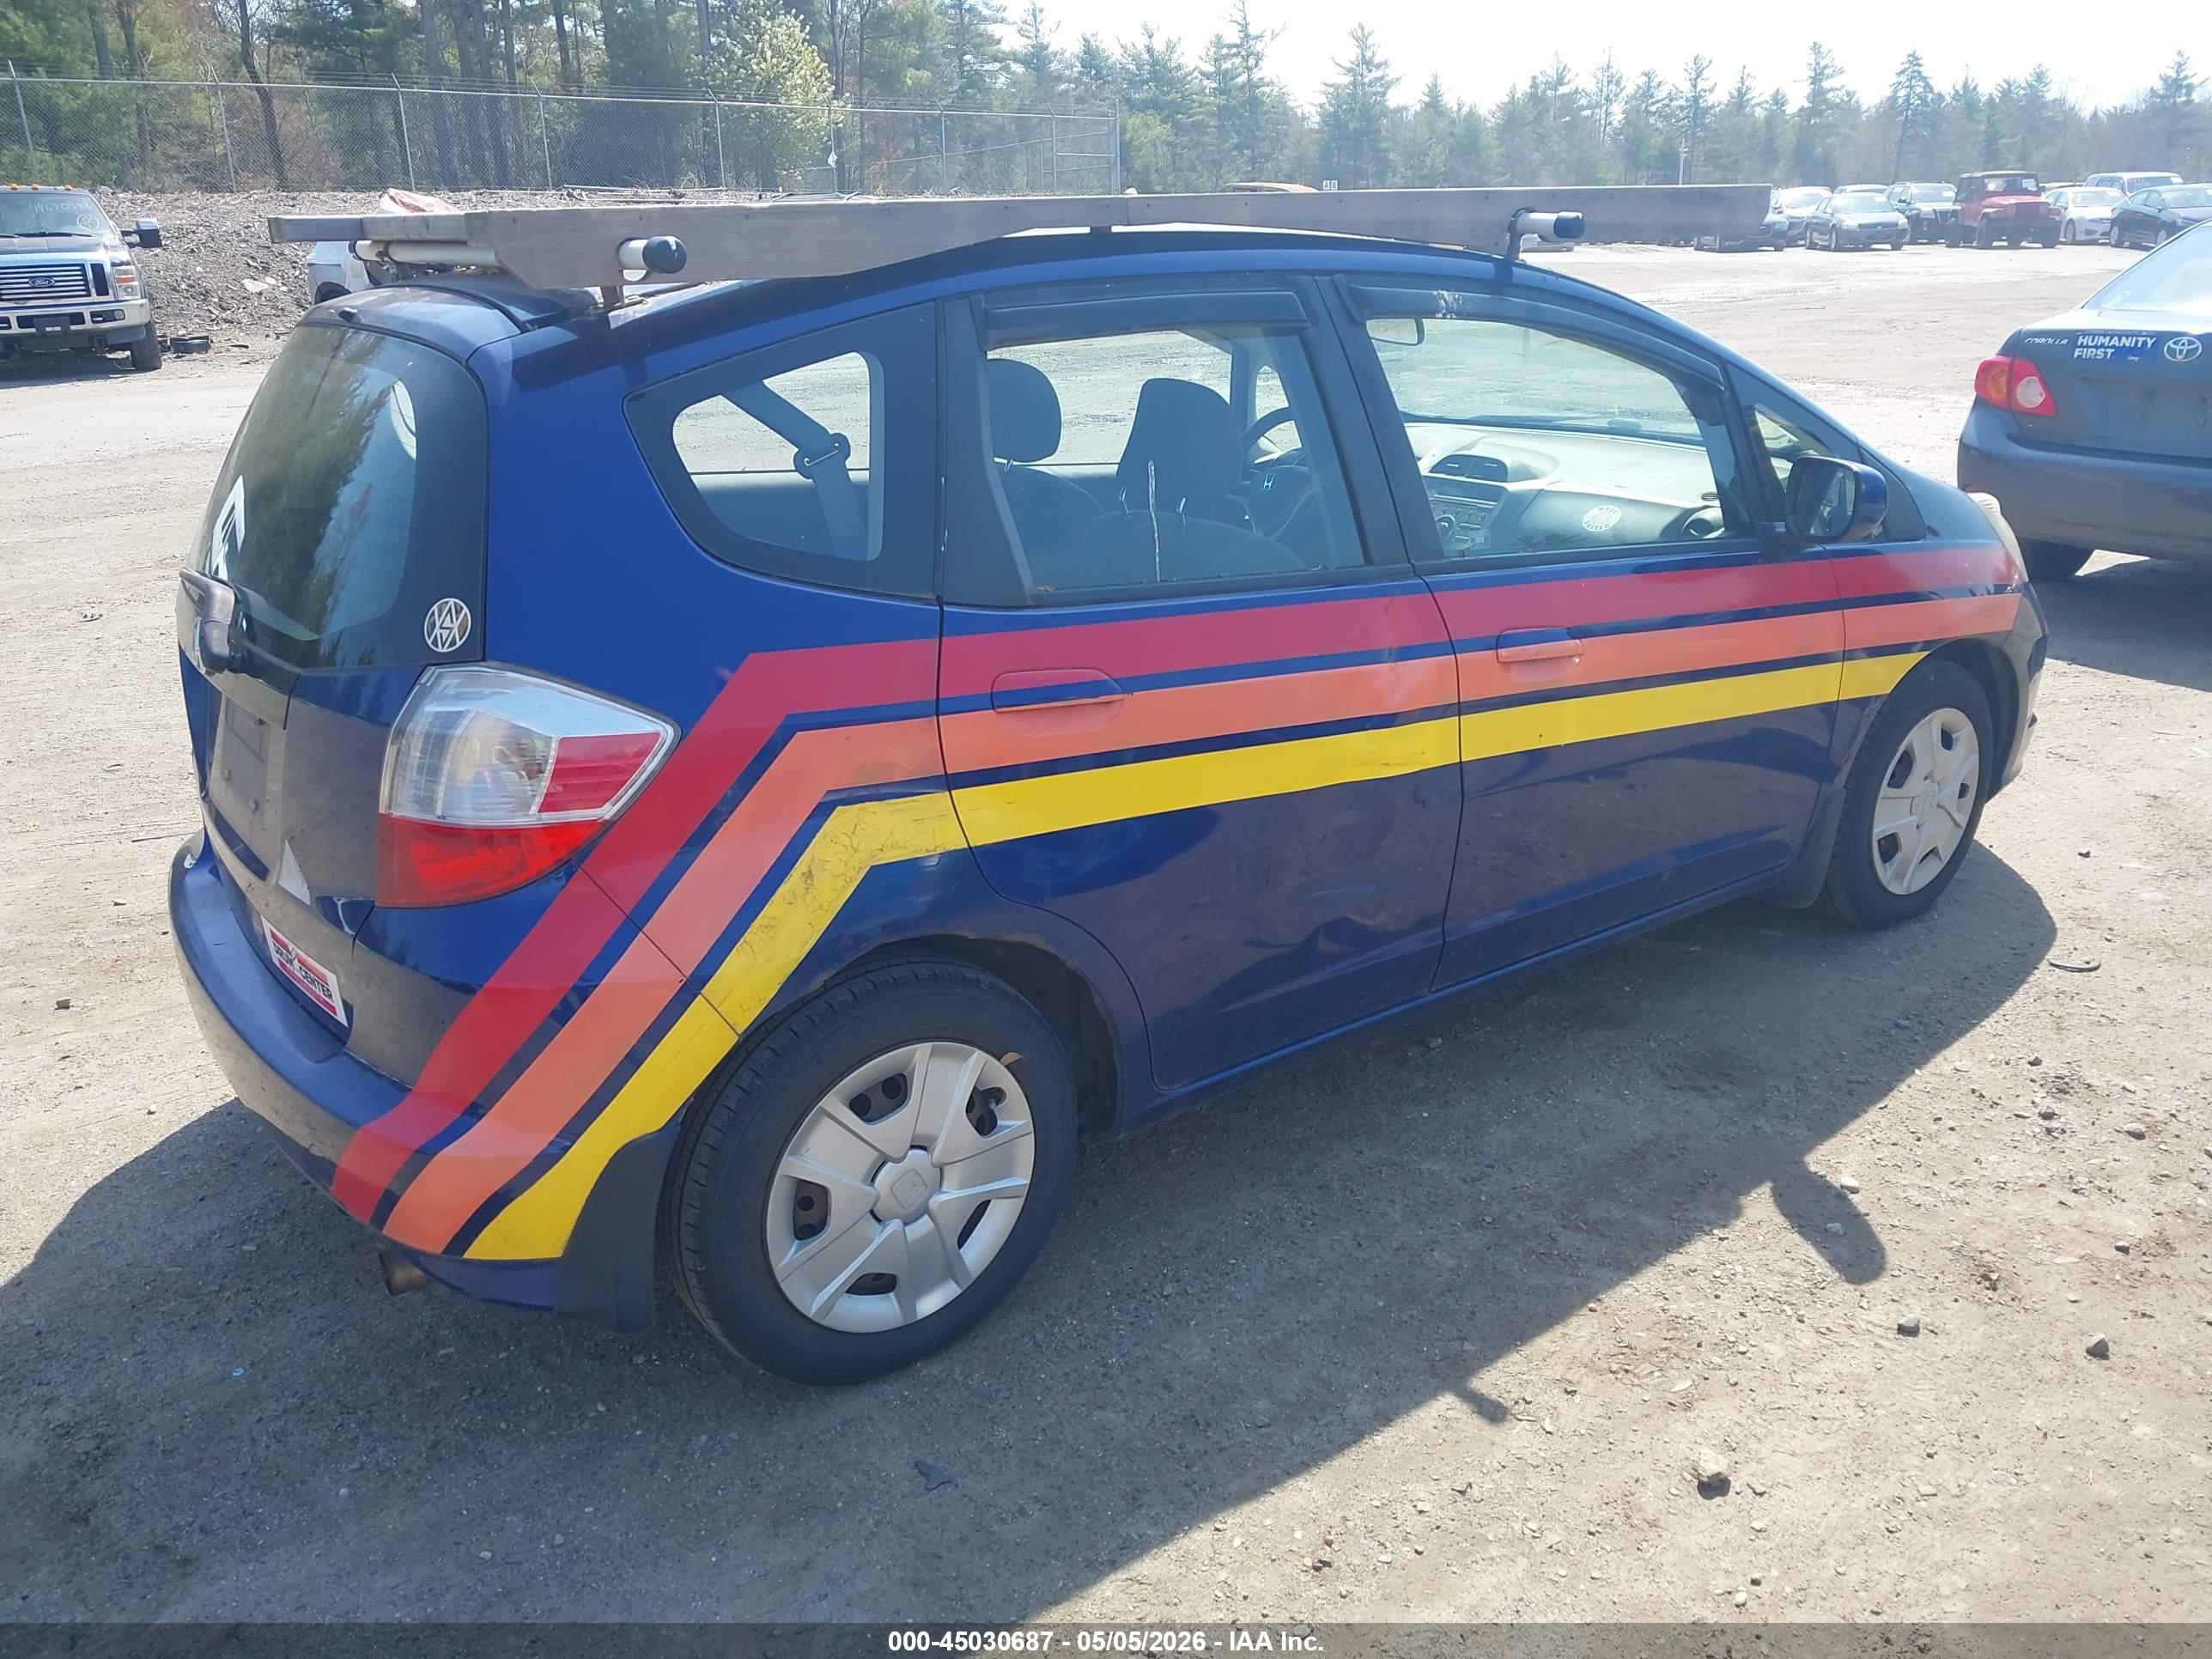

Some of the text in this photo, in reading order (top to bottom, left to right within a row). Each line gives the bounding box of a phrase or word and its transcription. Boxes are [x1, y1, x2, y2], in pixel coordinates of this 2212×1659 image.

[2077, 335, 2157, 348] HUMANITY
[2074, 348, 2115, 360] FIRST
[299, 965, 334, 1004] CENTER
